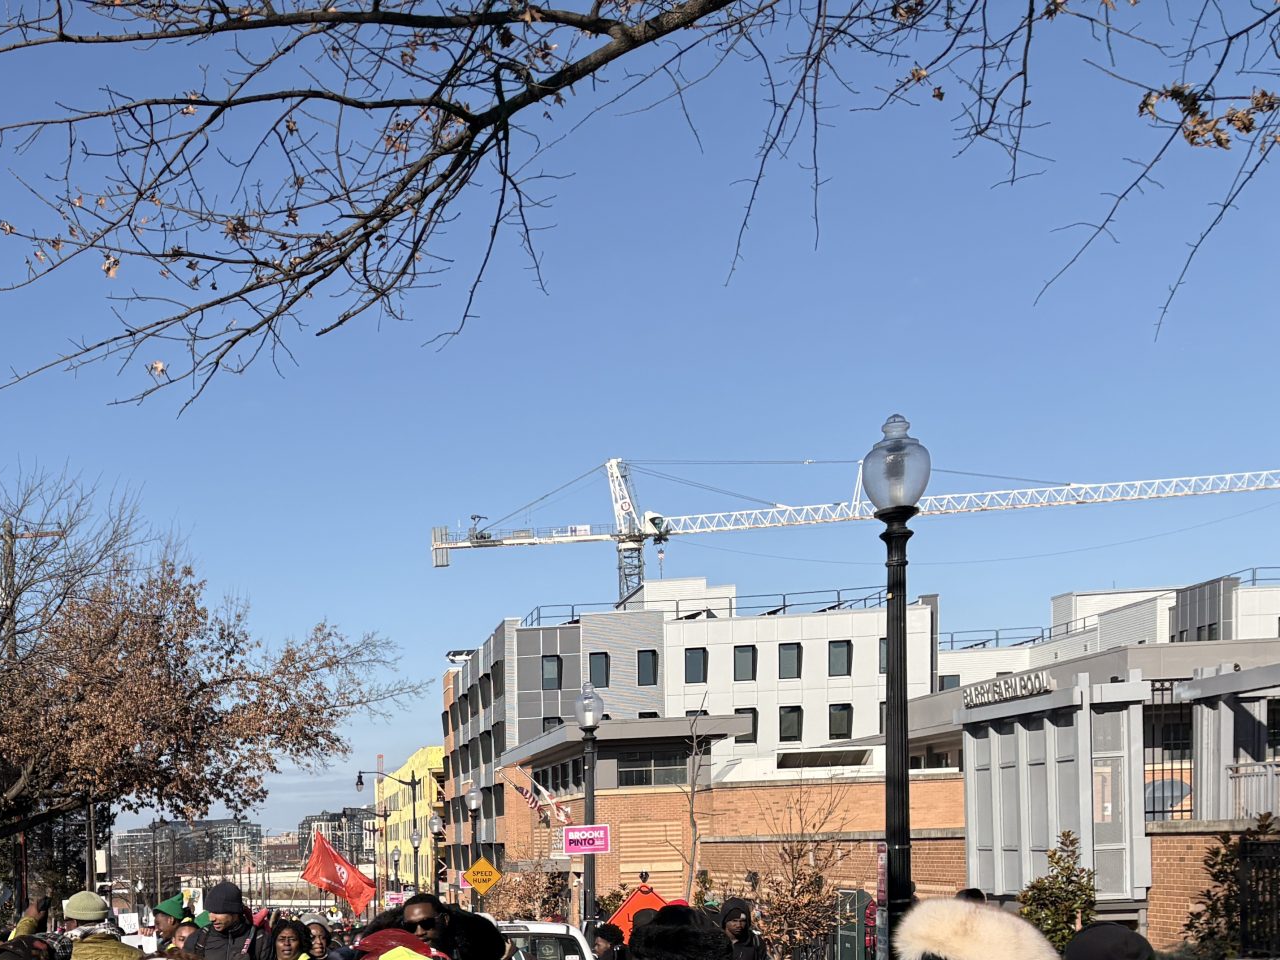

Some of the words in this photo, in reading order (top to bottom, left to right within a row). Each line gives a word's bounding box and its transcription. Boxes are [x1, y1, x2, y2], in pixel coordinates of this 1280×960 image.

[963, 684, 992, 705] BARRY
[992, 678, 1020, 700] FARM
[1020, 672, 1049, 696] POOL
[568, 831, 604, 839] BROOKE
[569, 838, 596, 847] PINTO
